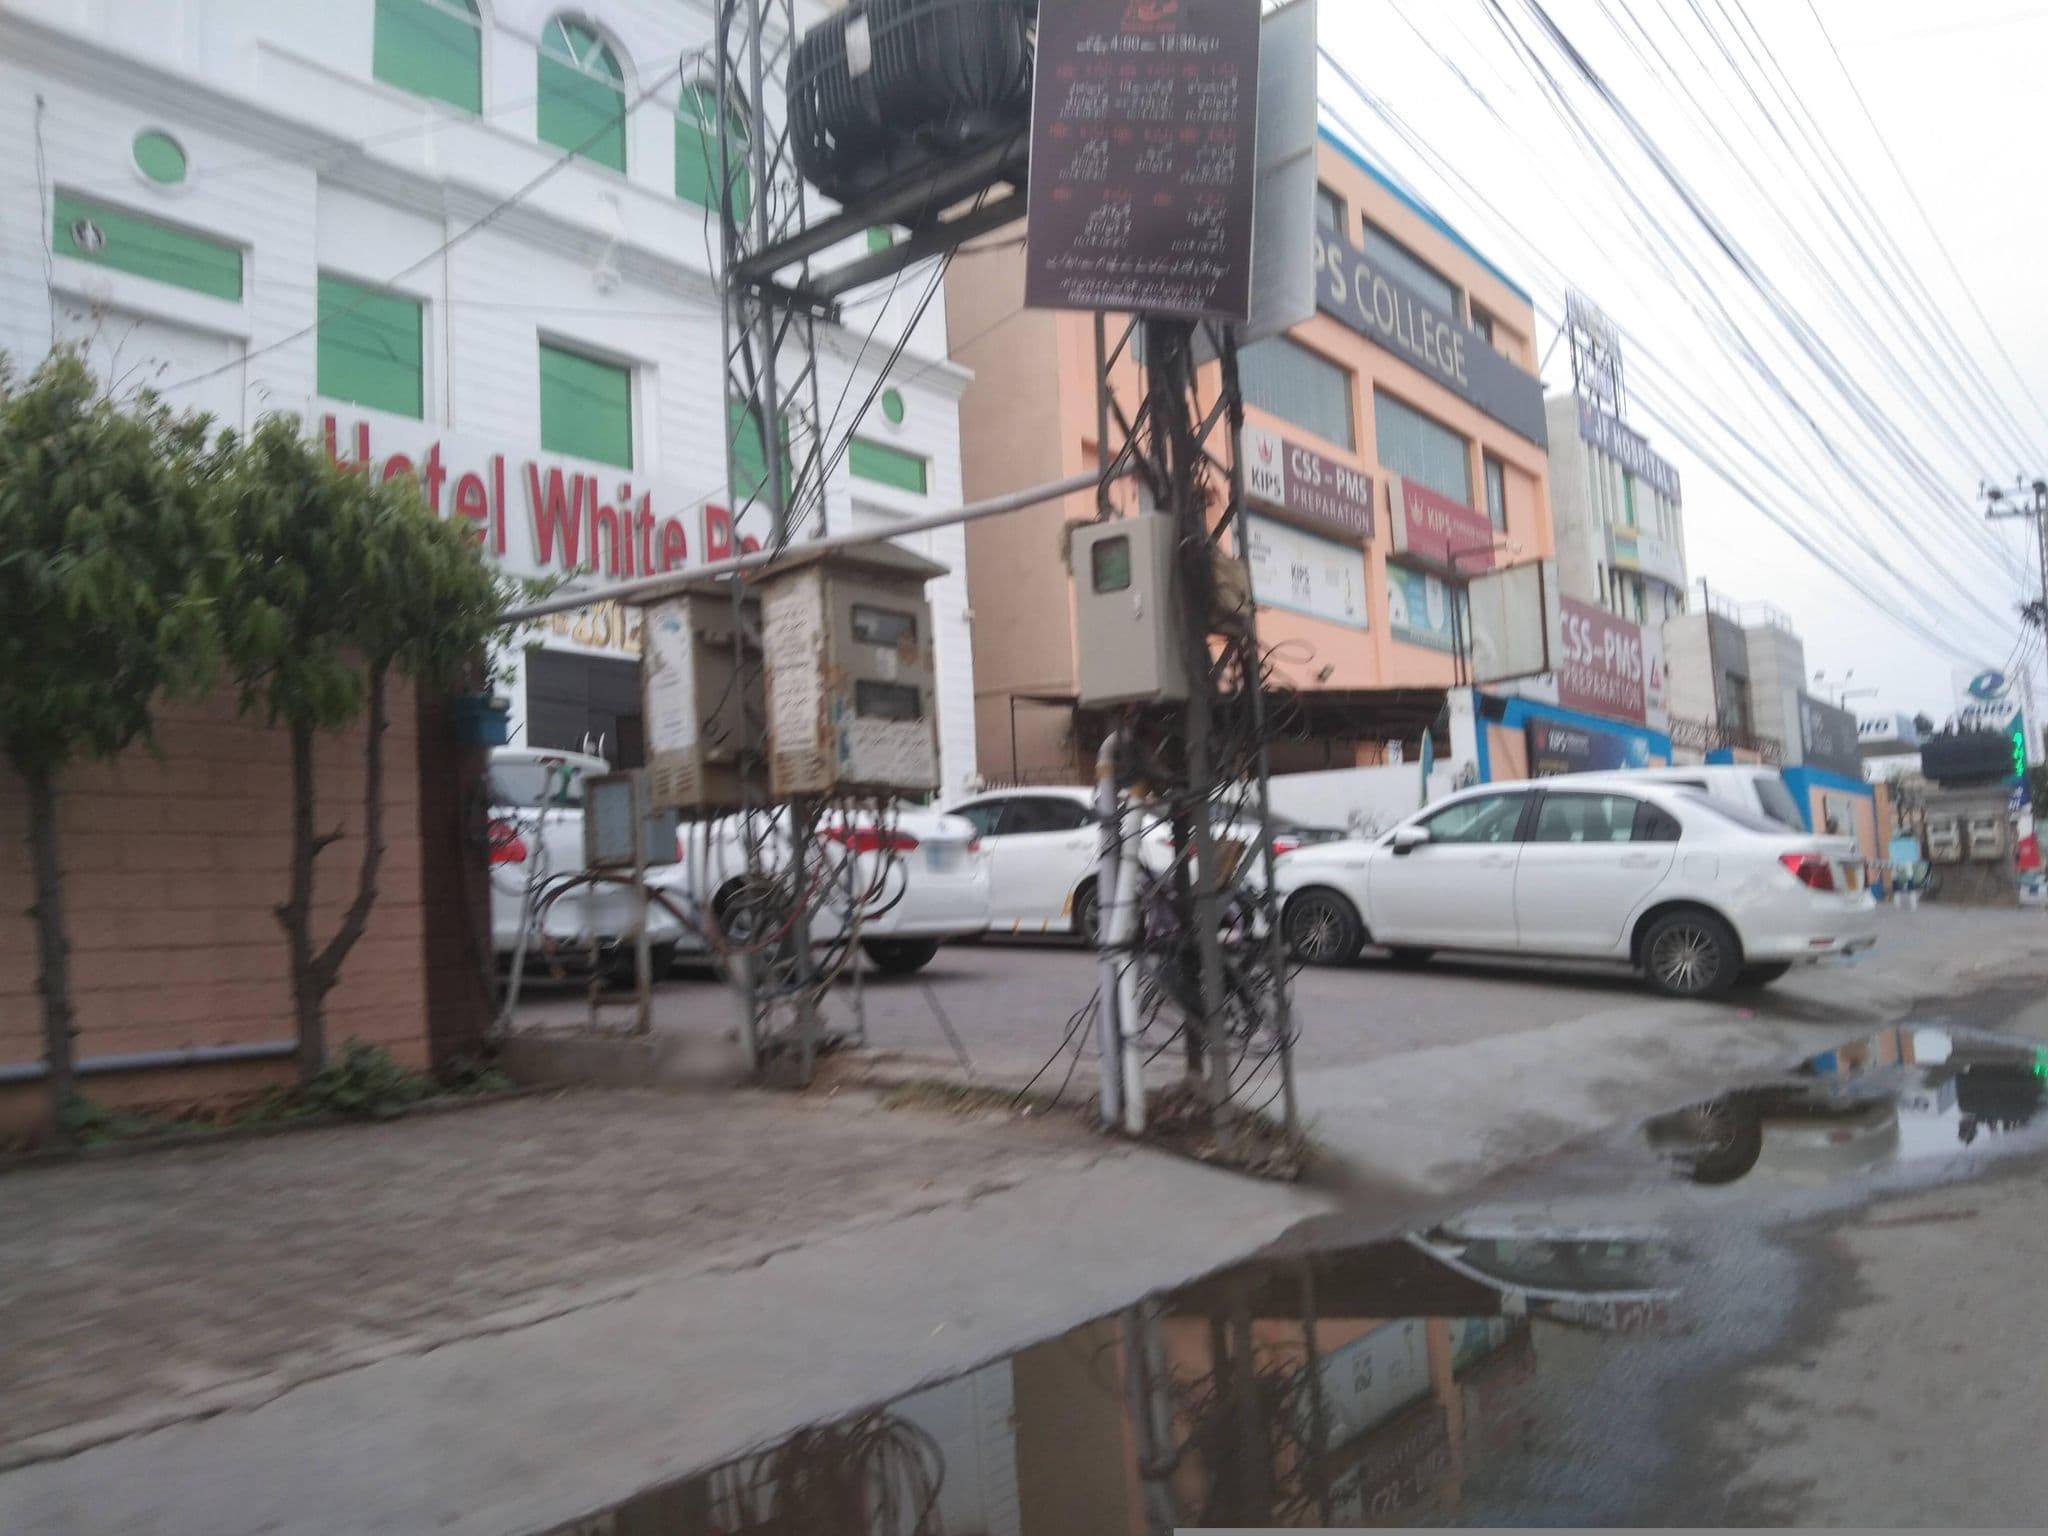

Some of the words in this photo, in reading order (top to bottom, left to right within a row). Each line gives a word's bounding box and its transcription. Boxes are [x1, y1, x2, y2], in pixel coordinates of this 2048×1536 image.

[1355, 263, 1468, 387] COLLEGE
[1251, 464, 1281, 497] KIPS
[528, 461, 688, 578] White
[1293, 483, 1369, 535] PREPARATION
[1562, 663, 1642, 713] PREPARATION
